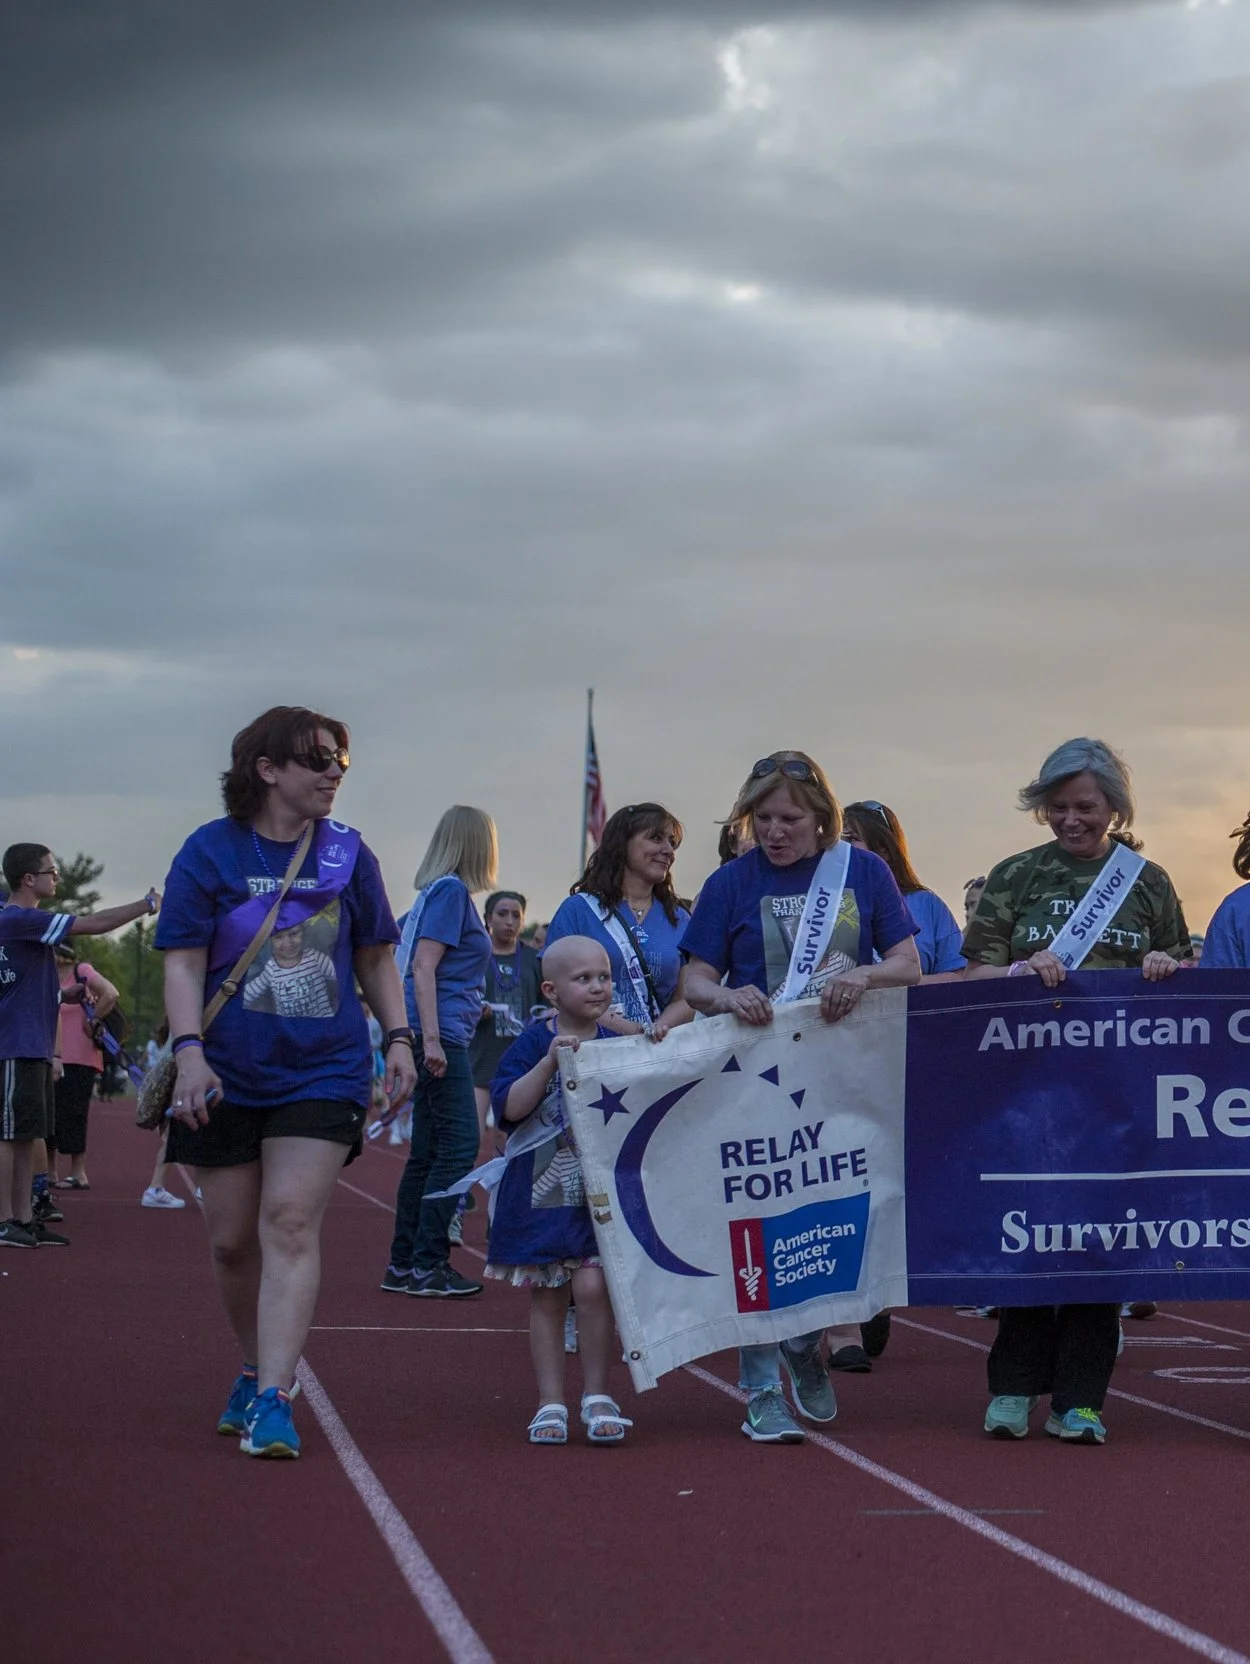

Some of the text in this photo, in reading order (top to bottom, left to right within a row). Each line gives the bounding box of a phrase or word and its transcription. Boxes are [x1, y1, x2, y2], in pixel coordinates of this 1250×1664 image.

[1071, 867, 1126, 941] Survivor
[797, 887, 831, 975] Survivor
[978, 1009, 1210, 1051] American
[719, 1121, 825, 1169] RELAY
[723, 1147, 868, 1204] FOR LIFE
[772, 1221, 856, 1254] American
[773, 1241, 831, 1269] Cancer
[775, 1256, 838, 1287] Society
